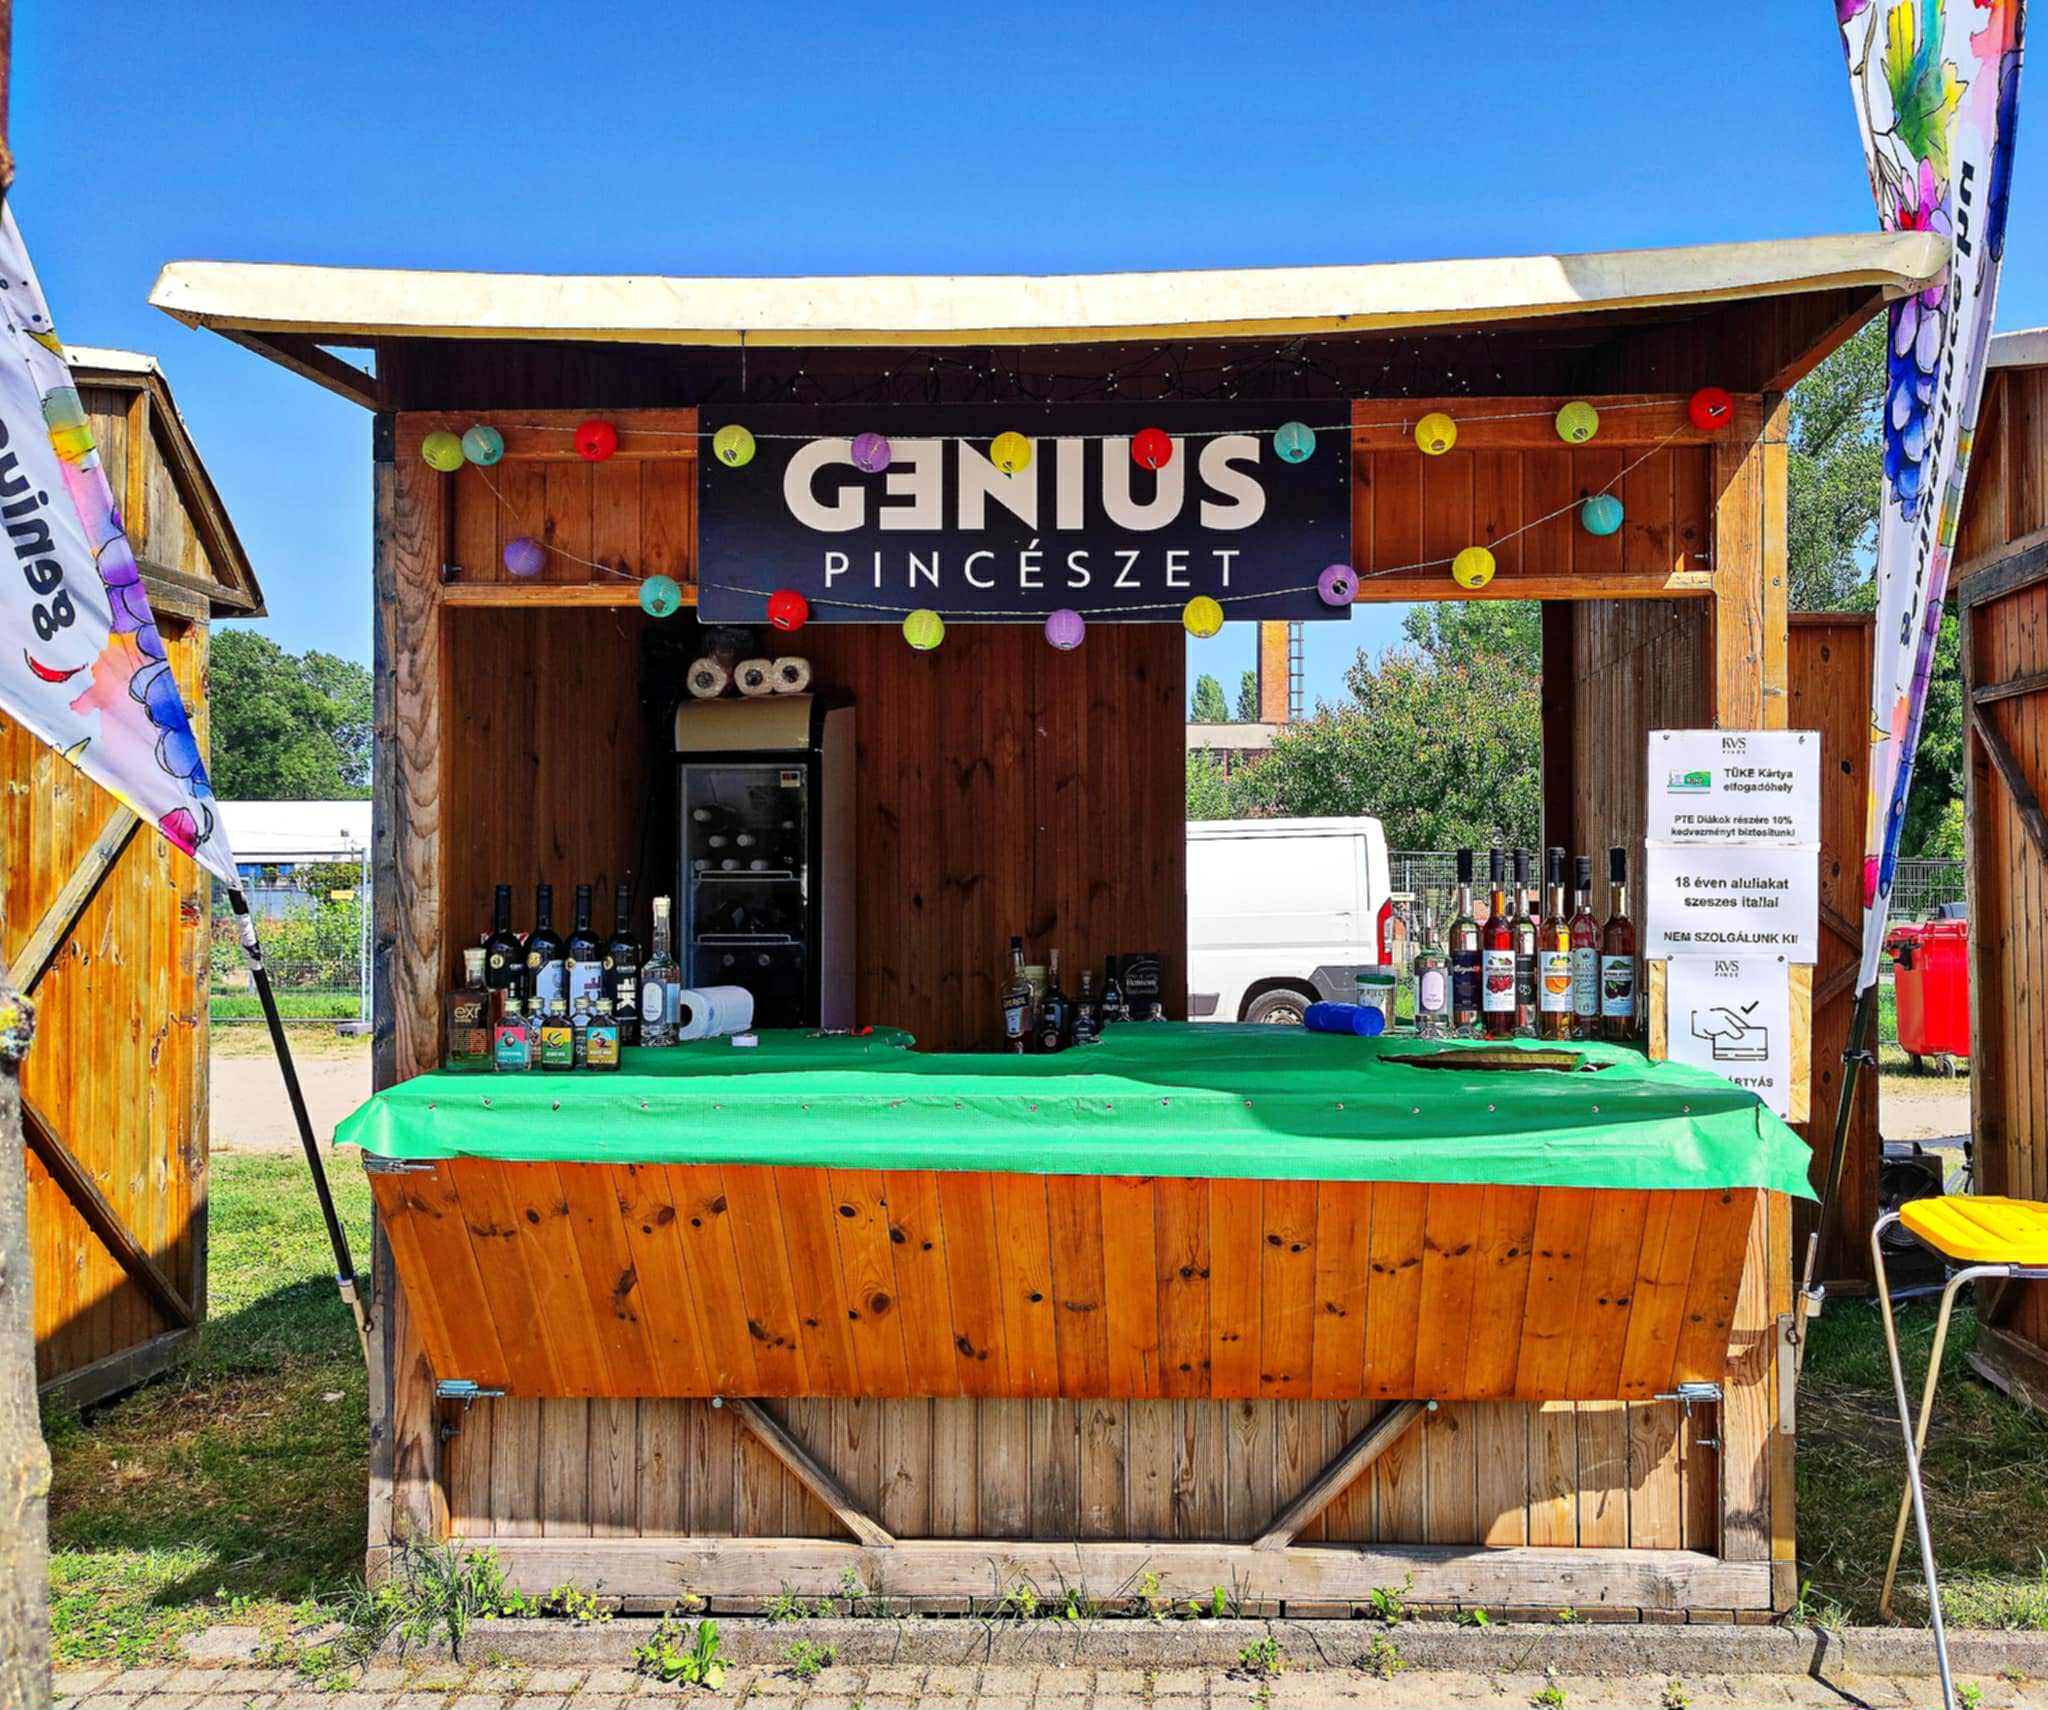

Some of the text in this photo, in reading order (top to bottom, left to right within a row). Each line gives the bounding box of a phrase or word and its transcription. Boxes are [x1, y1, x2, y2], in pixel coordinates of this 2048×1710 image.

[824, 539, 1241, 588] PINCÉSZET
[1722, 737, 1747, 749] KVS
[1724, 766, 1794, 782] TÜKE Kártya
[1723, 781, 1794, 794] elfogadóhely
[1674, 814, 1793, 825] PTE Diákok részére 10%
[1671, 827, 1736, 838] kedvezményt
[1675, 876, 1789, 890] 18 éven aluliakat
[1684, 896, 1779, 909] szeszes itallal
[1664, 931, 1691, 942] NEM
[1694, 931, 1779, 944] SZOLGÁLUNK
[1714, 960, 1740, 971] KVS
